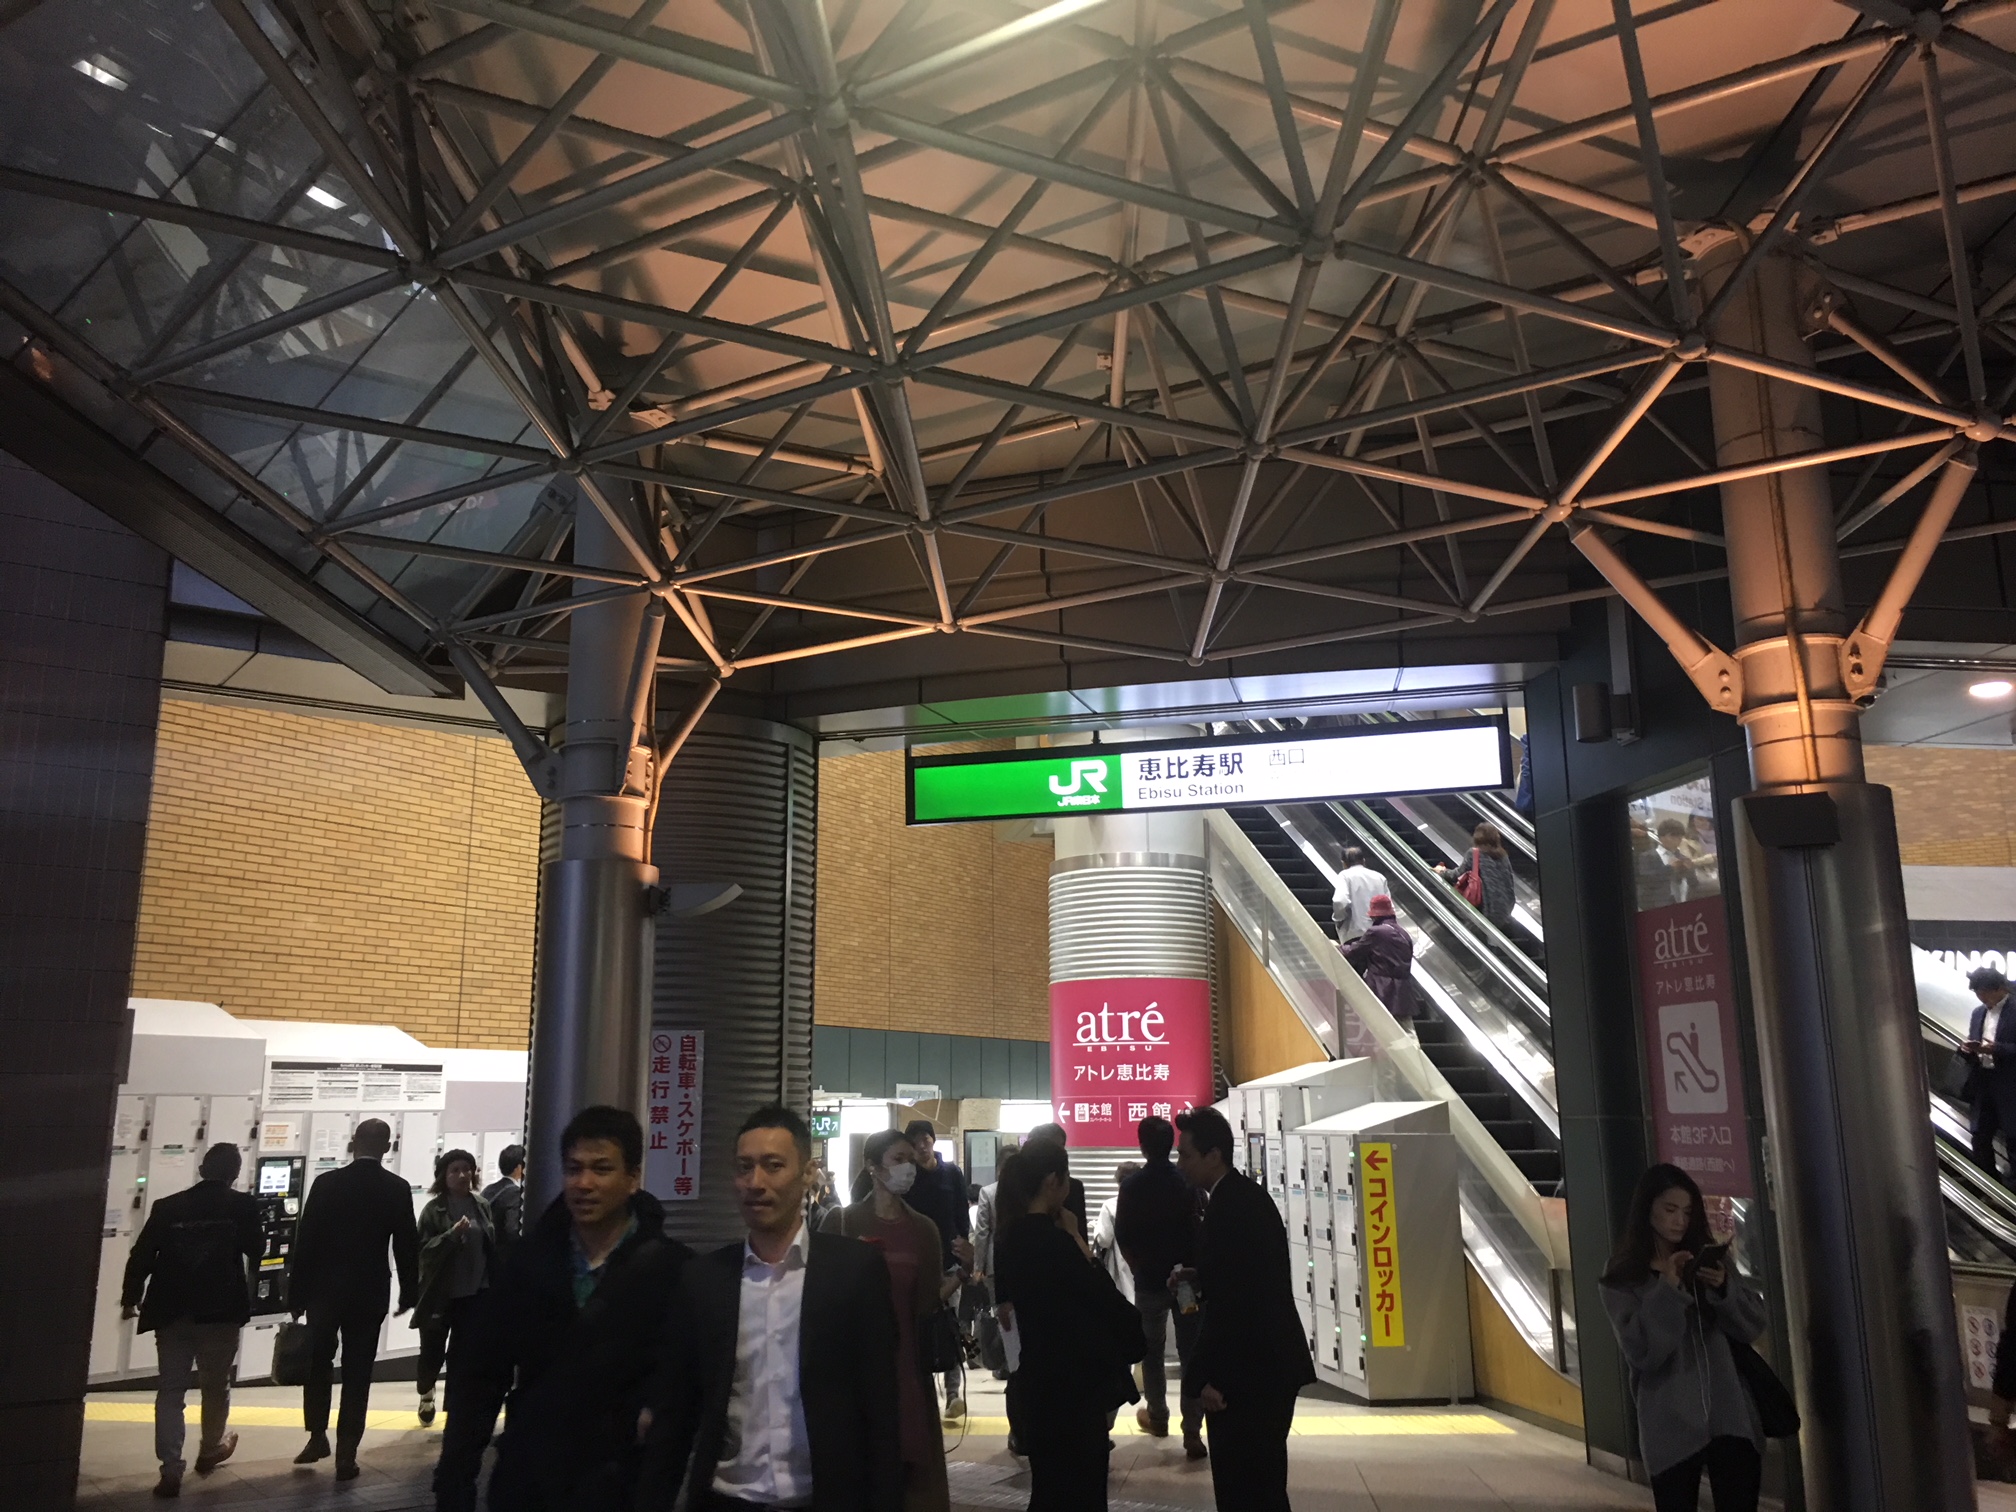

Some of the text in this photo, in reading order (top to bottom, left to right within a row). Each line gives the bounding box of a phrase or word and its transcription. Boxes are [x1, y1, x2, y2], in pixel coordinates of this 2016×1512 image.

[1049, 759, 1108, 795] JR
[1138, 748, 1305, 781] 恵比寿駅 西口
[1138, 782, 1245, 800] Ebisu Station
[1653, 912, 1710, 961] atré
[1655, 973, 1716, 994] アトレ恵比寿
[1076, 1001, 1165, 1043] atré
[1073, 1063, 1170, 1082] アトレ恵比寿
[649, 1055, 671, 1150] 走行禁止
[673, 1034, 698, 1196] 自転車・スケボー等
[1089, 1102, 1112, 1116] 本館
[1127, 1101, 1172, 1122] 西館
[816, 1117, 831, 1131] JR
[1669, 1123, 1733, 1145] 本館3F入口
[1368, 1177, 1395, 1337] コインロッカー
